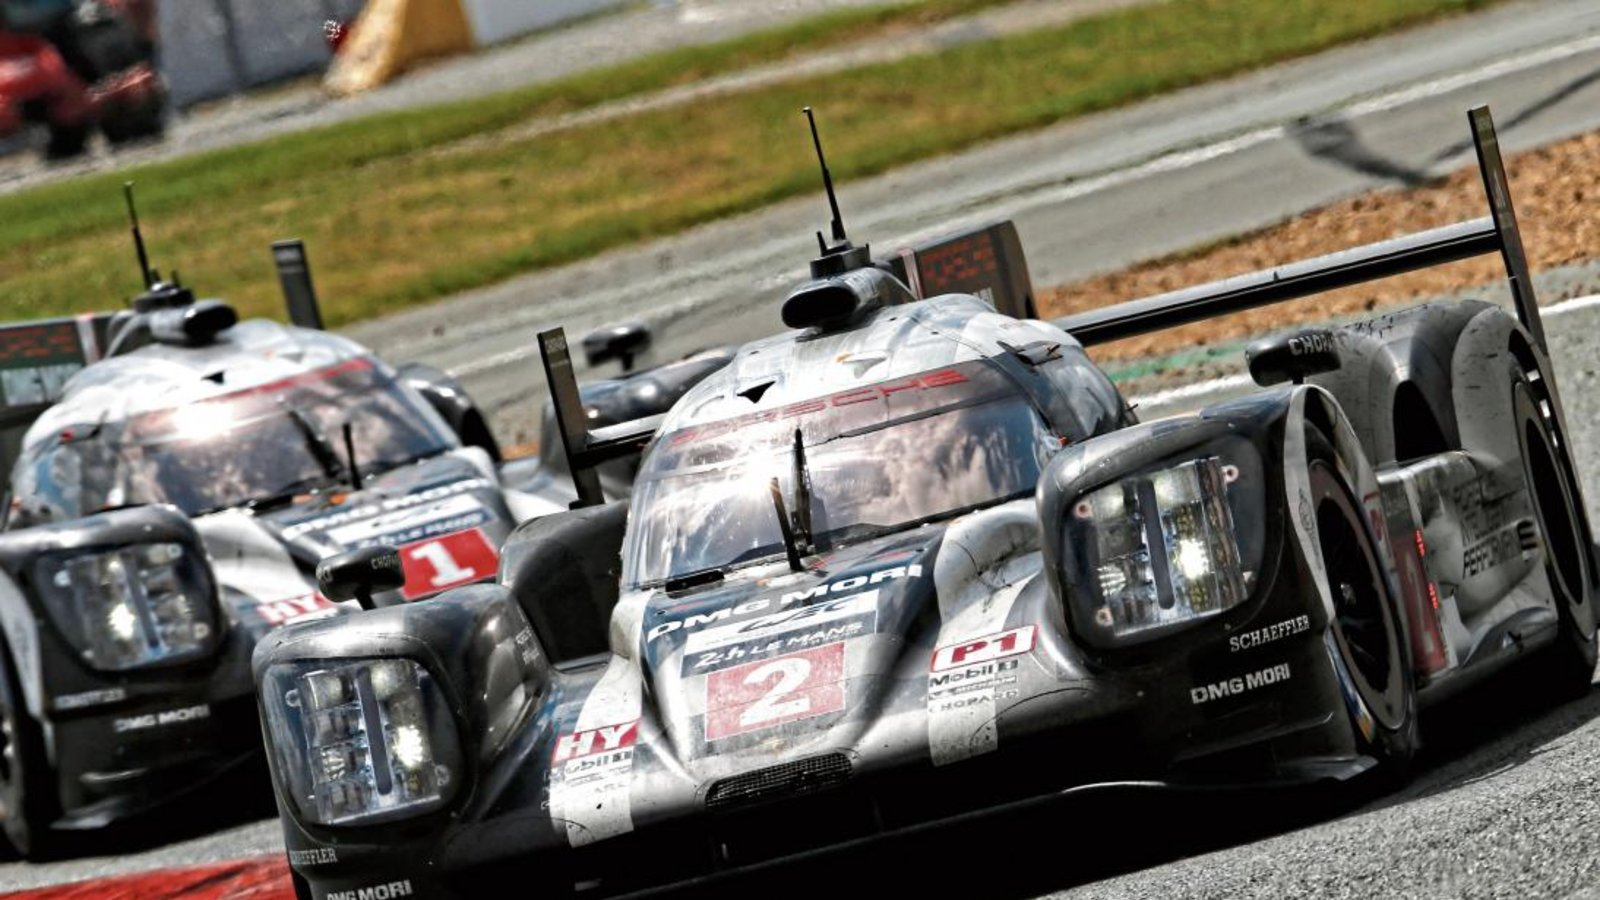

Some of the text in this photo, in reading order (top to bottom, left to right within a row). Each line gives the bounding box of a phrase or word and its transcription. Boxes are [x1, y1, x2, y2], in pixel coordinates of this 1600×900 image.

[409, 540, 475, 586] 1
[647, 564, 923, 643] DMG MORI
[750, 640, 782, 655] LE
[786, 622, 865, 650] MANS
[951, 632, 1018, 663] P1
[1229, 614, 1310, 653] SCHAEFFLER
[741, 657, 811, 726] 2
[929, 664, 994, 688] Mobil
[1190, 662, 1290, 704] DMG MORI
[158, 704, 210, 725] MORI
[553, 720, 637, 764] HY
[357, 879, 412, 900] MORI
